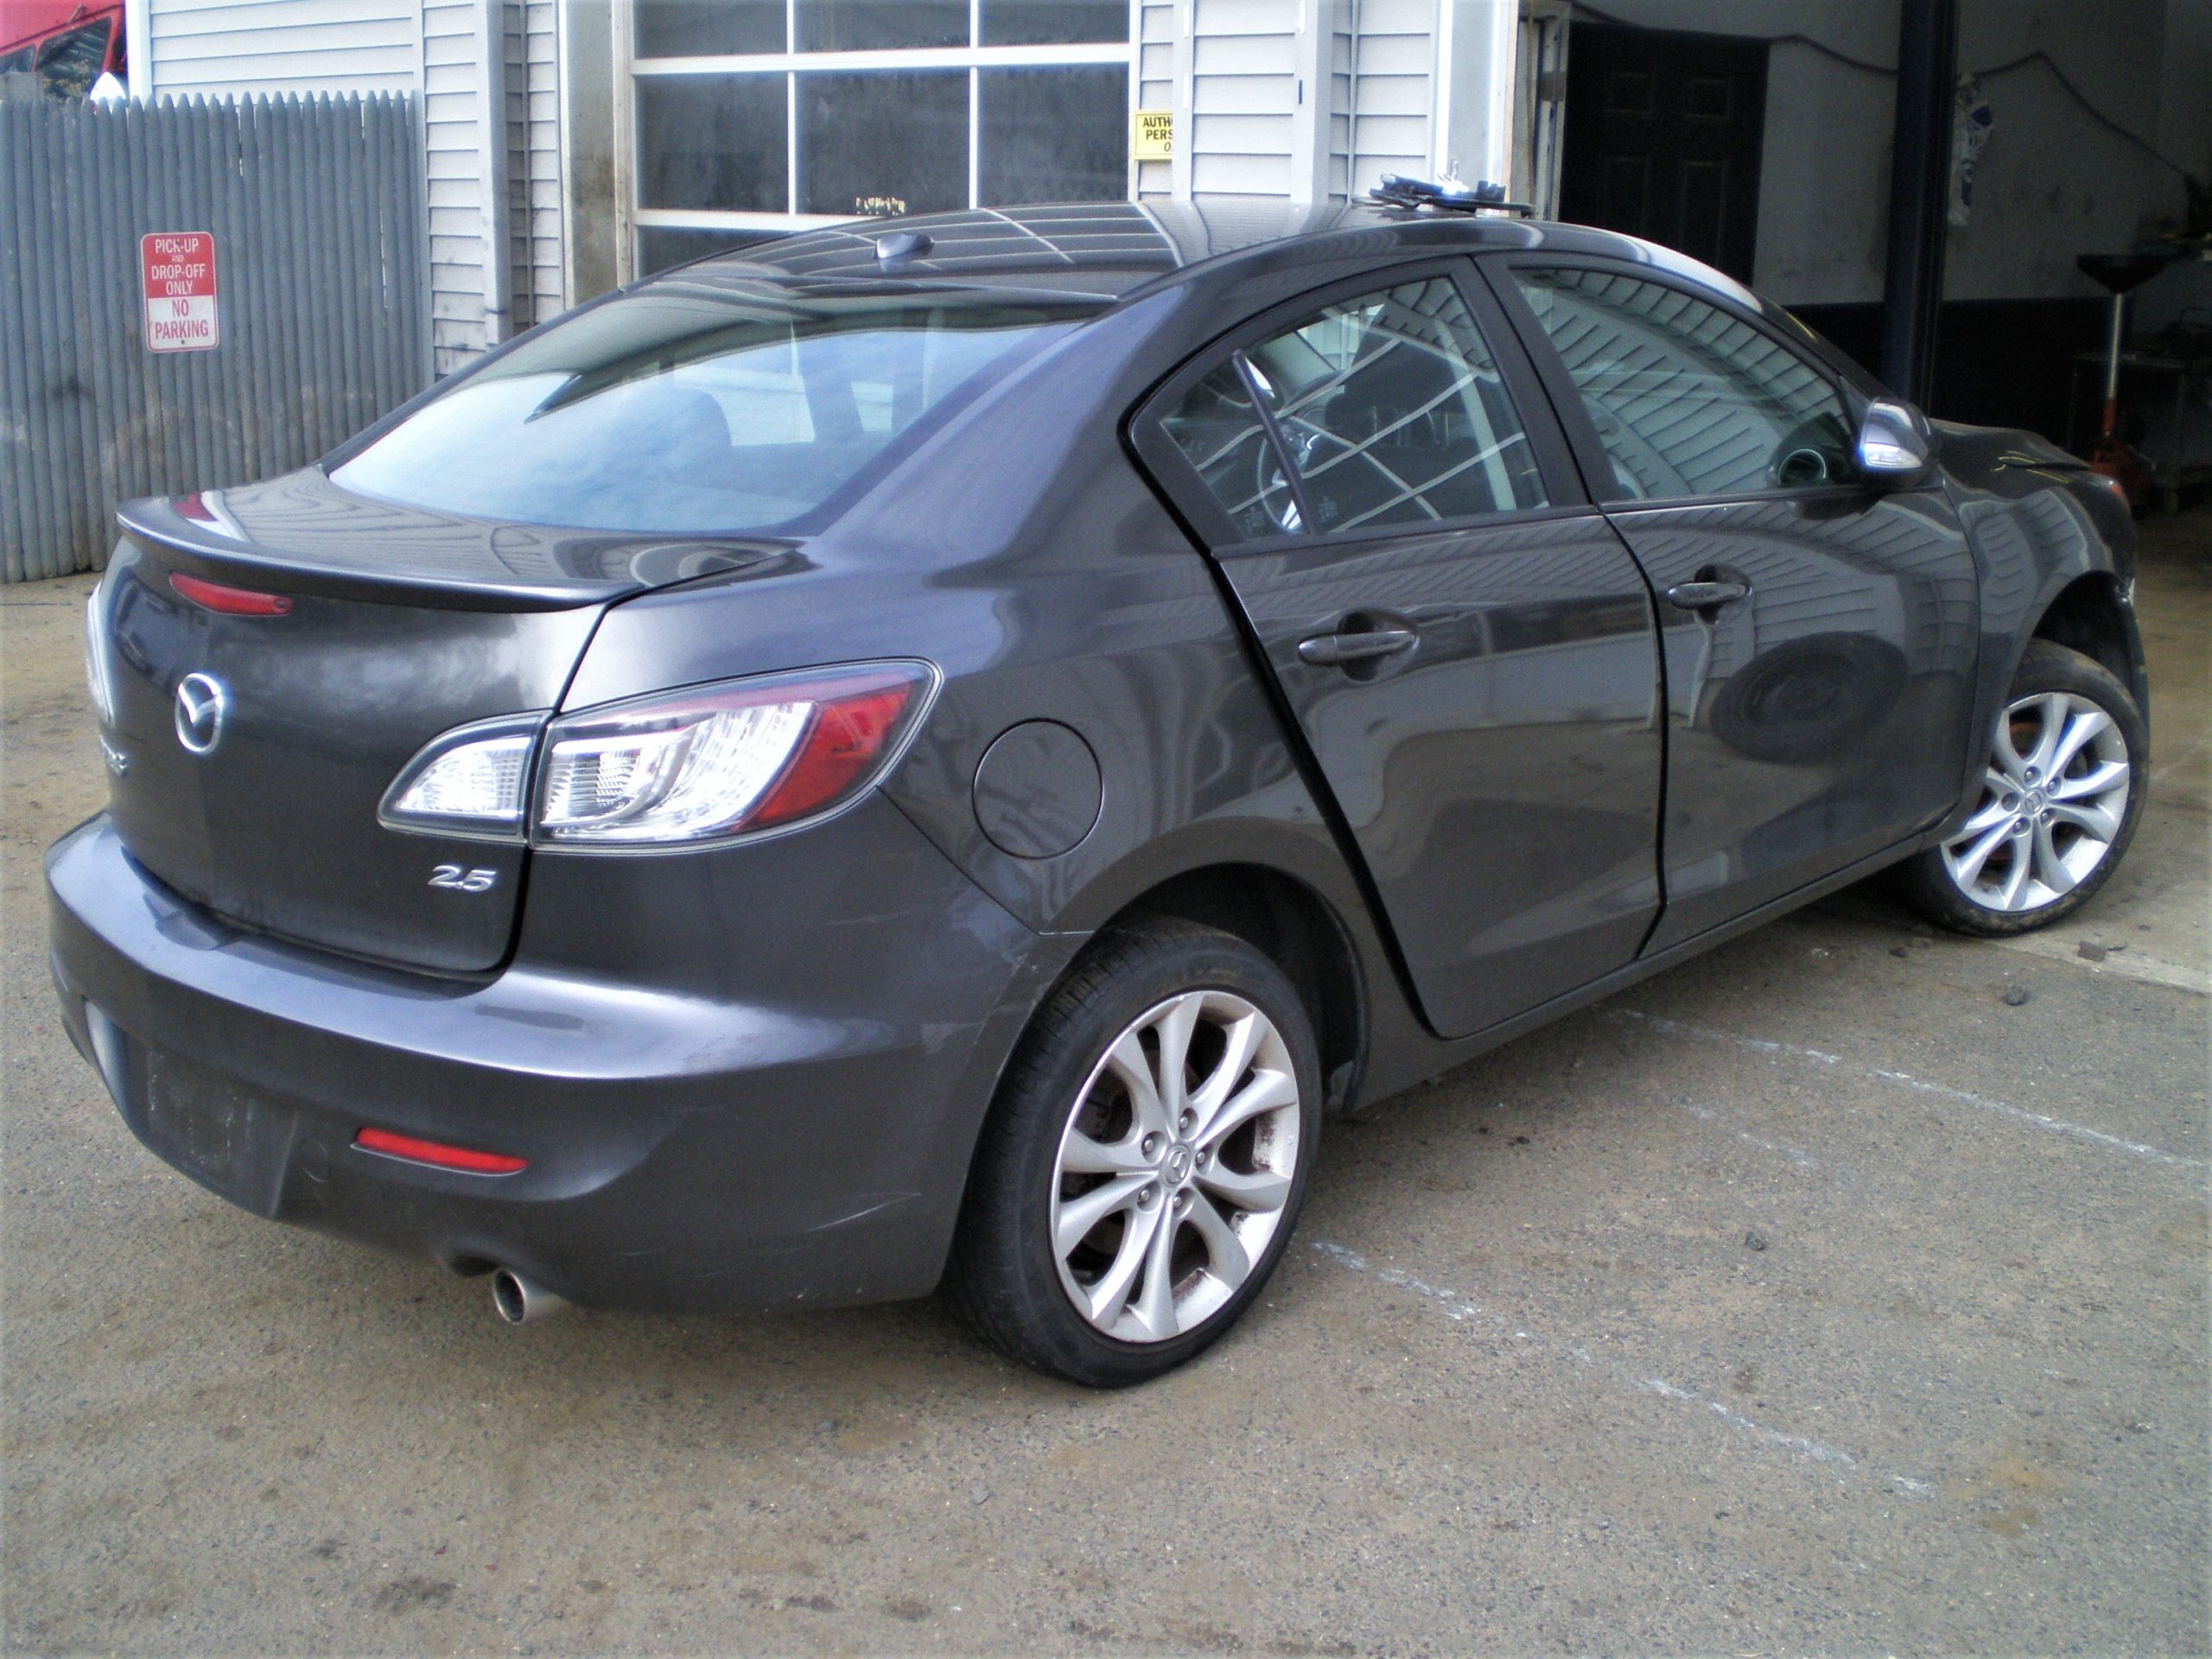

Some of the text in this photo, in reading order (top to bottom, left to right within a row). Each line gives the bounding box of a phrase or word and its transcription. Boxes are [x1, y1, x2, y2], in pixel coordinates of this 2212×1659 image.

[155, 238, 199, 254] PICK-UP
[151, 264, 206, 280] DROP-OFF
[166, 280, 194, 296] ONLY
[172, 299, 189, 317] NO
[155, 319, 209, 340] PARKING
